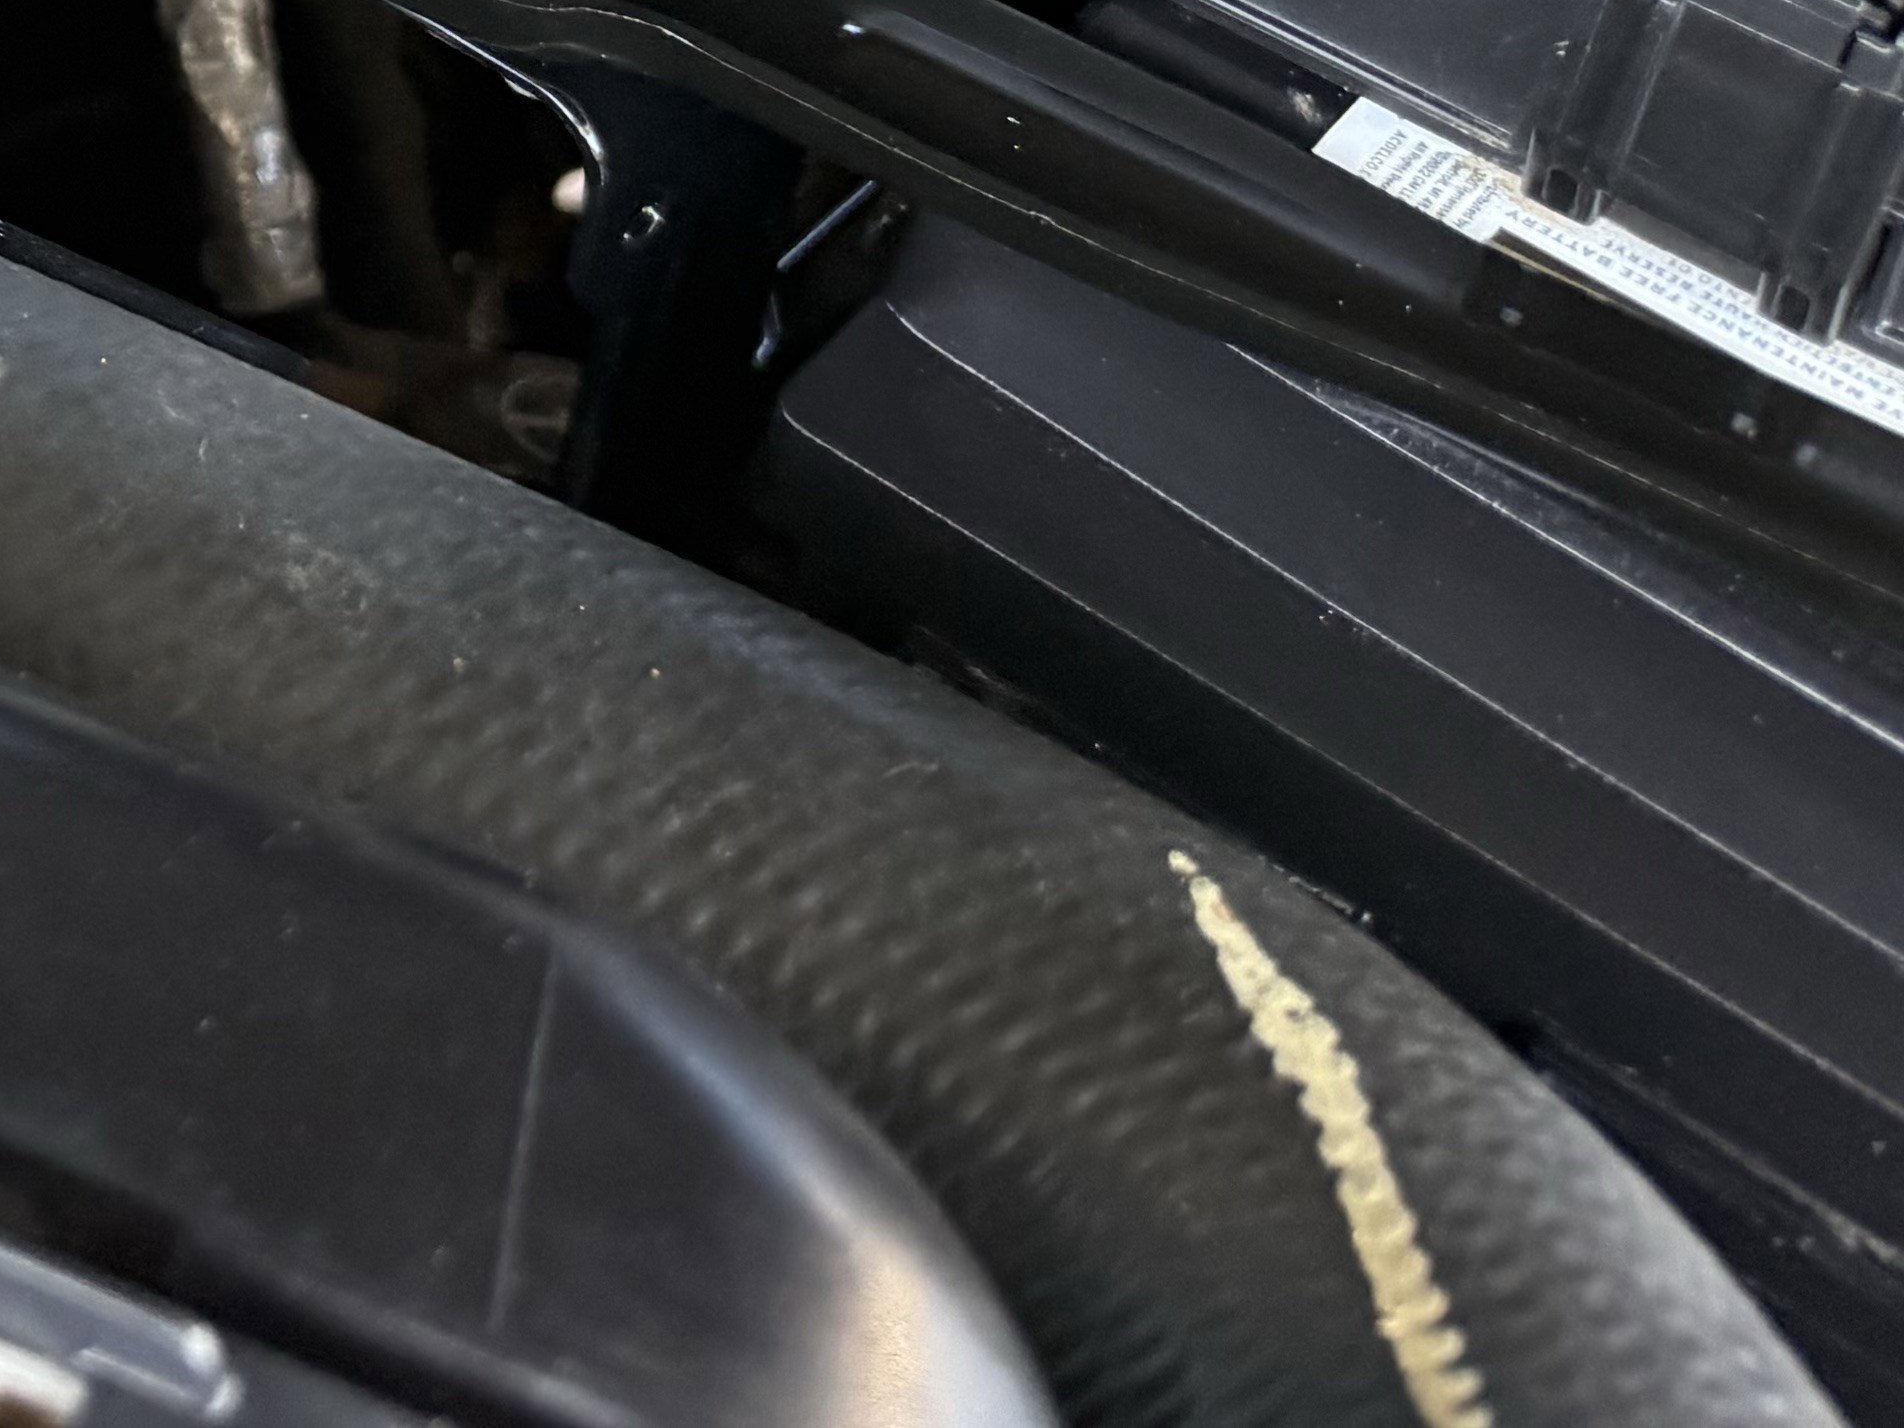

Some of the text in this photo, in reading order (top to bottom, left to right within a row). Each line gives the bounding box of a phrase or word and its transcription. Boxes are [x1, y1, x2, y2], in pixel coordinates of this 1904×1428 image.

[1505, 209, 1616, 269] BATTERY
[1618, 264, 1682, 302] FREE
[1687, 302, 1866, 401] MAINTENANCE
